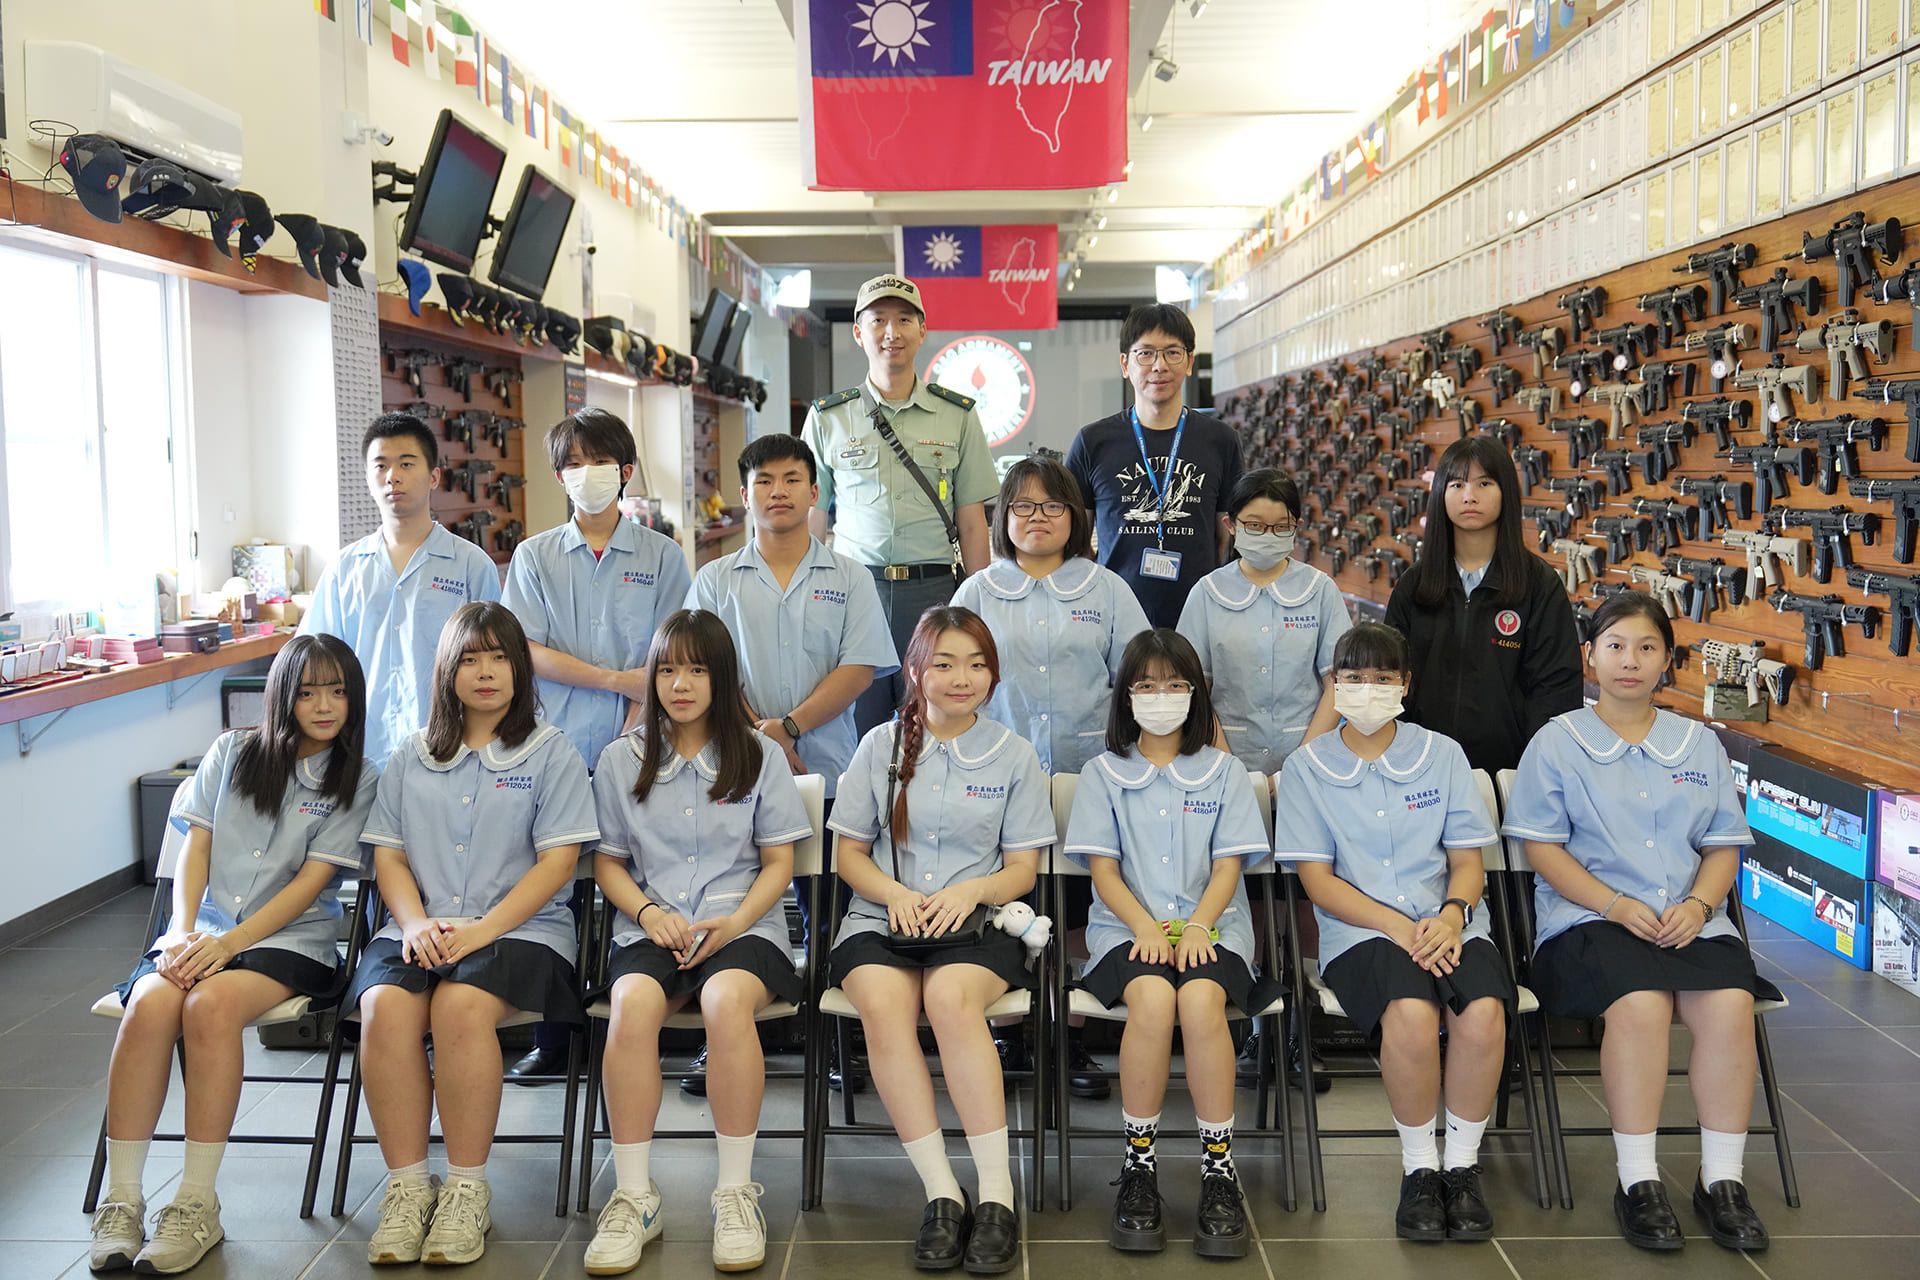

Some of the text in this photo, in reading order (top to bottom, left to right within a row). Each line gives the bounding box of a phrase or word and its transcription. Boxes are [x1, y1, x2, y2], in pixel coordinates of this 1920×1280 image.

[988, 58, 1112, 86] TAIWAN
[988, 268, 1050, 283] TAIWAN
[1115, 456, 1206, 490] NAUTICA
[1121, 495, 1139, 503] EST.
[1166, 527, 1195, 536] CLUB
[1798, 795, 1822, 815] GUN
